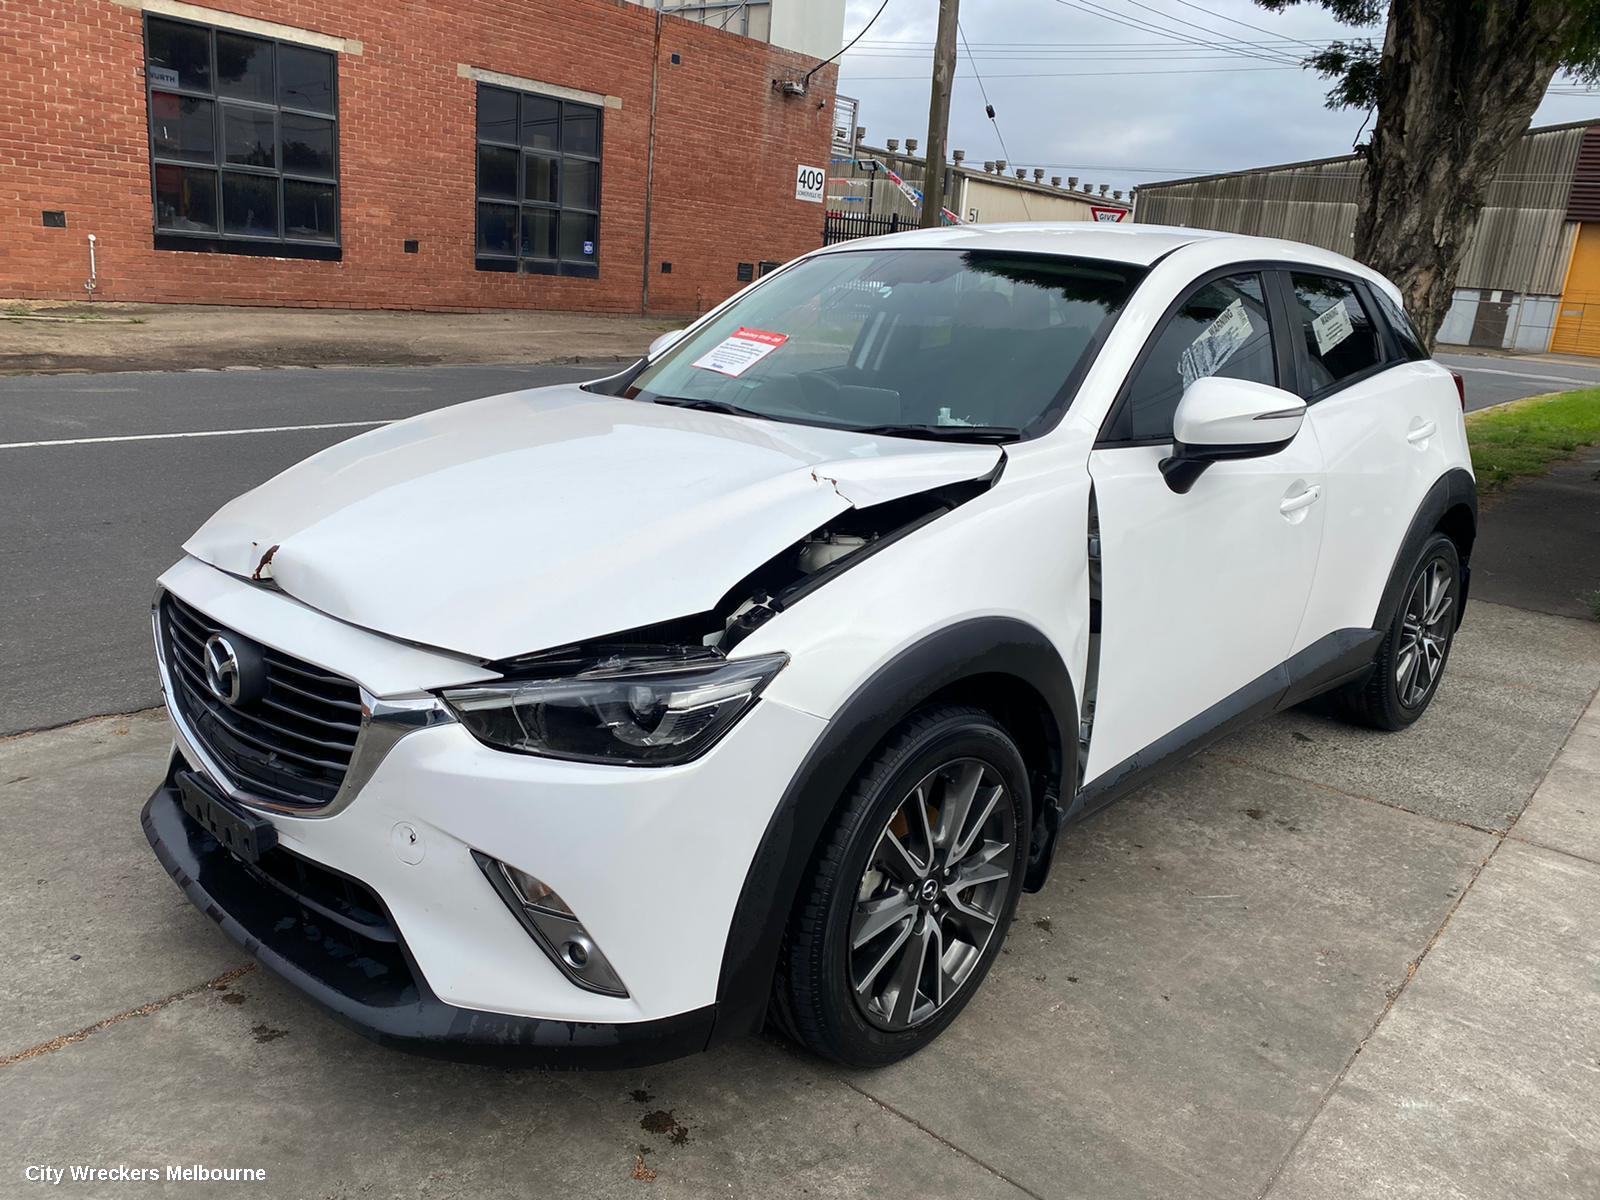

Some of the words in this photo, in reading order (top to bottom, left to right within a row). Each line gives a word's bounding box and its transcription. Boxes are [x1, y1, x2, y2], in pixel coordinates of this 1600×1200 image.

[798, 169, 823, 190] 409
[969, 208, 979, 222] 51
[1099, 213, 1116, 222] GIVE
[1208, 308, 1234, 336] WARNING
